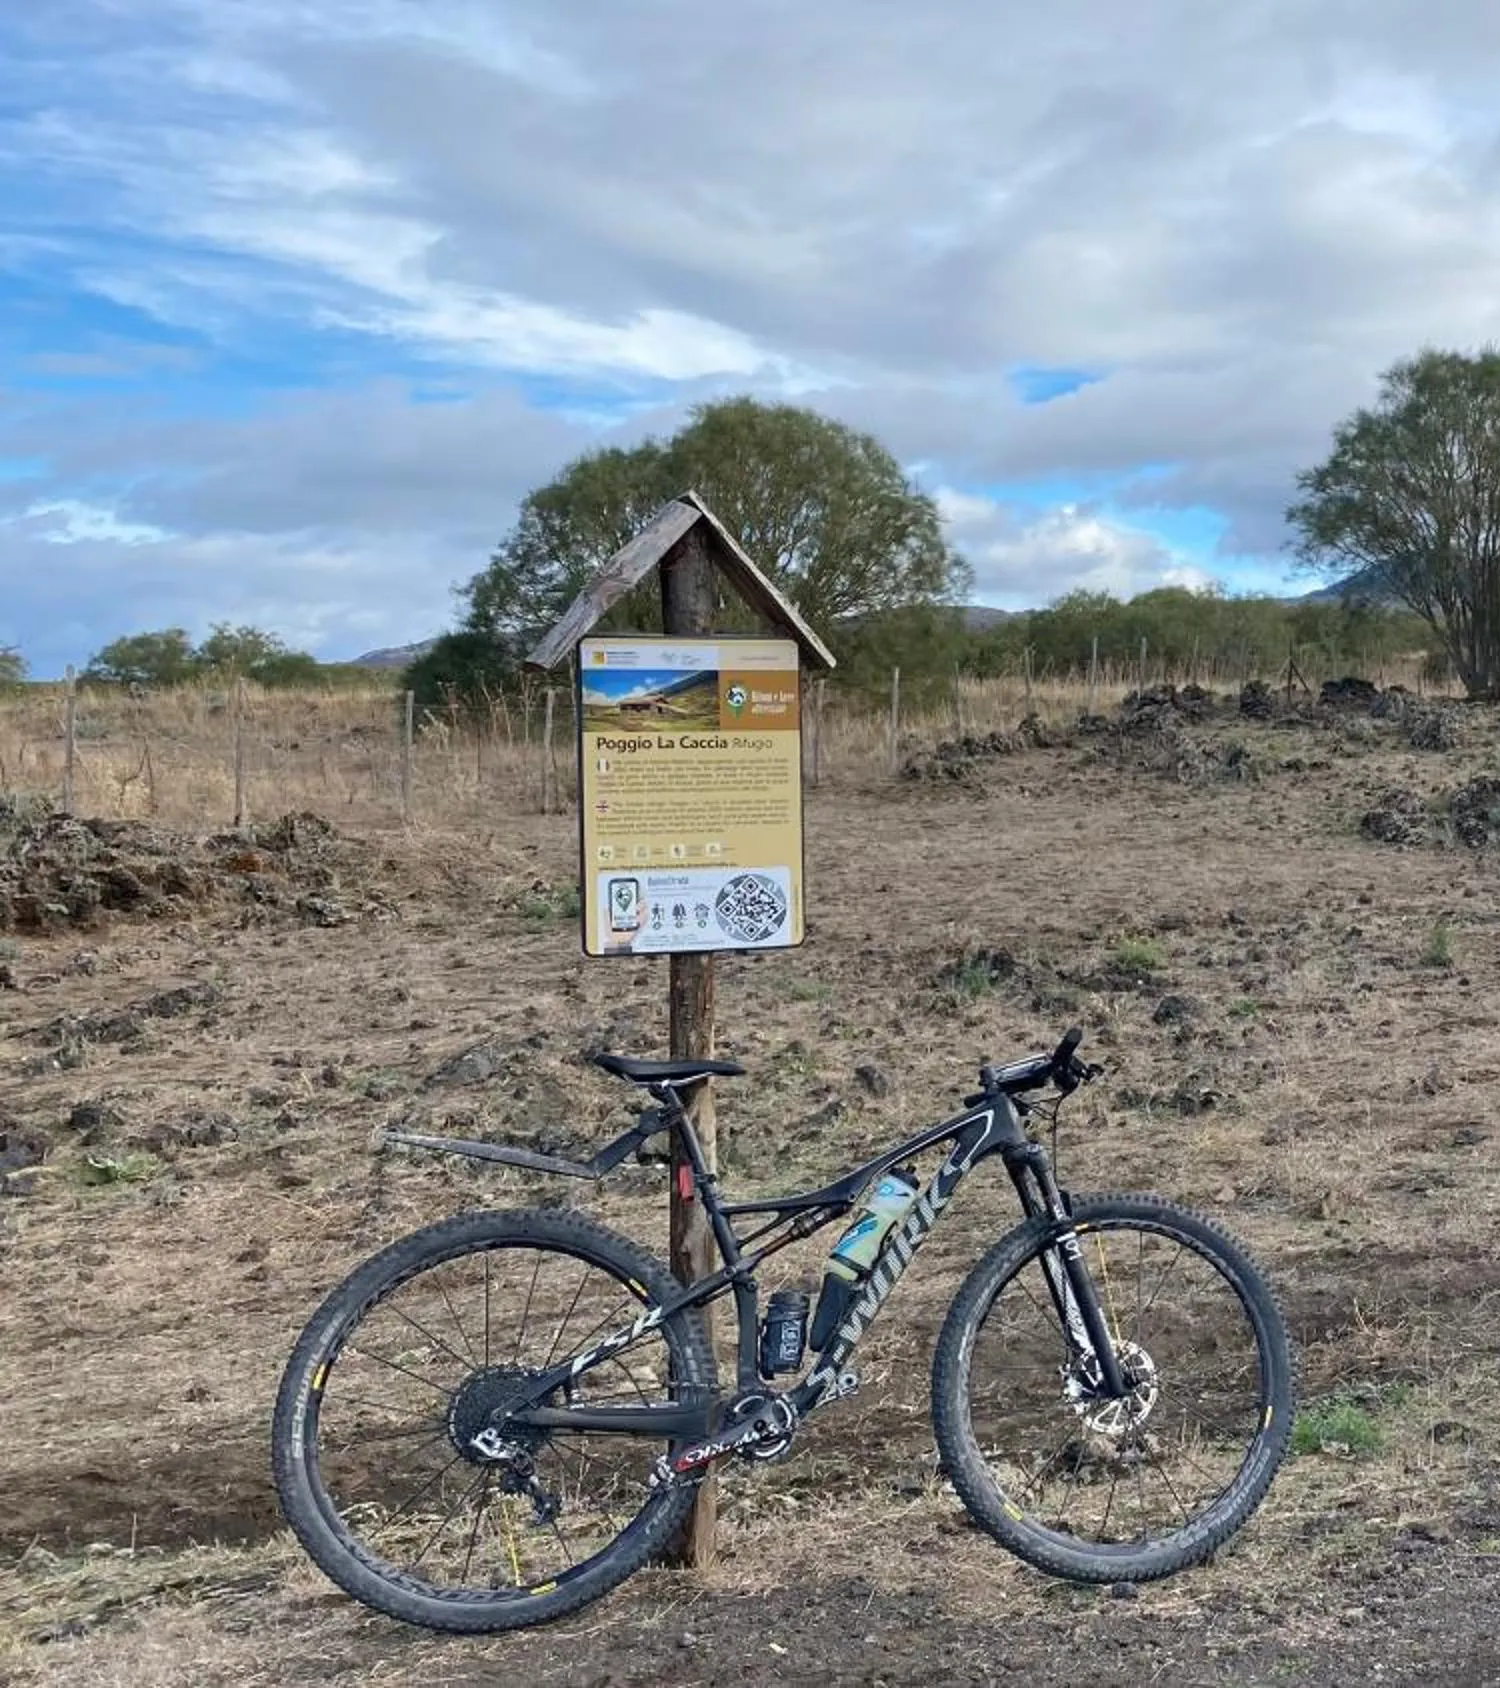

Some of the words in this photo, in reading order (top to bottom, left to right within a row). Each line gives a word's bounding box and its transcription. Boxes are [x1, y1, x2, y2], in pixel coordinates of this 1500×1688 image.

[596, 735, 653, 752] Poggio
[657, 736, 675, 749] La
[679, 735, 728, 749] Caccia
[732, 737, 773, 751] Rifugio
